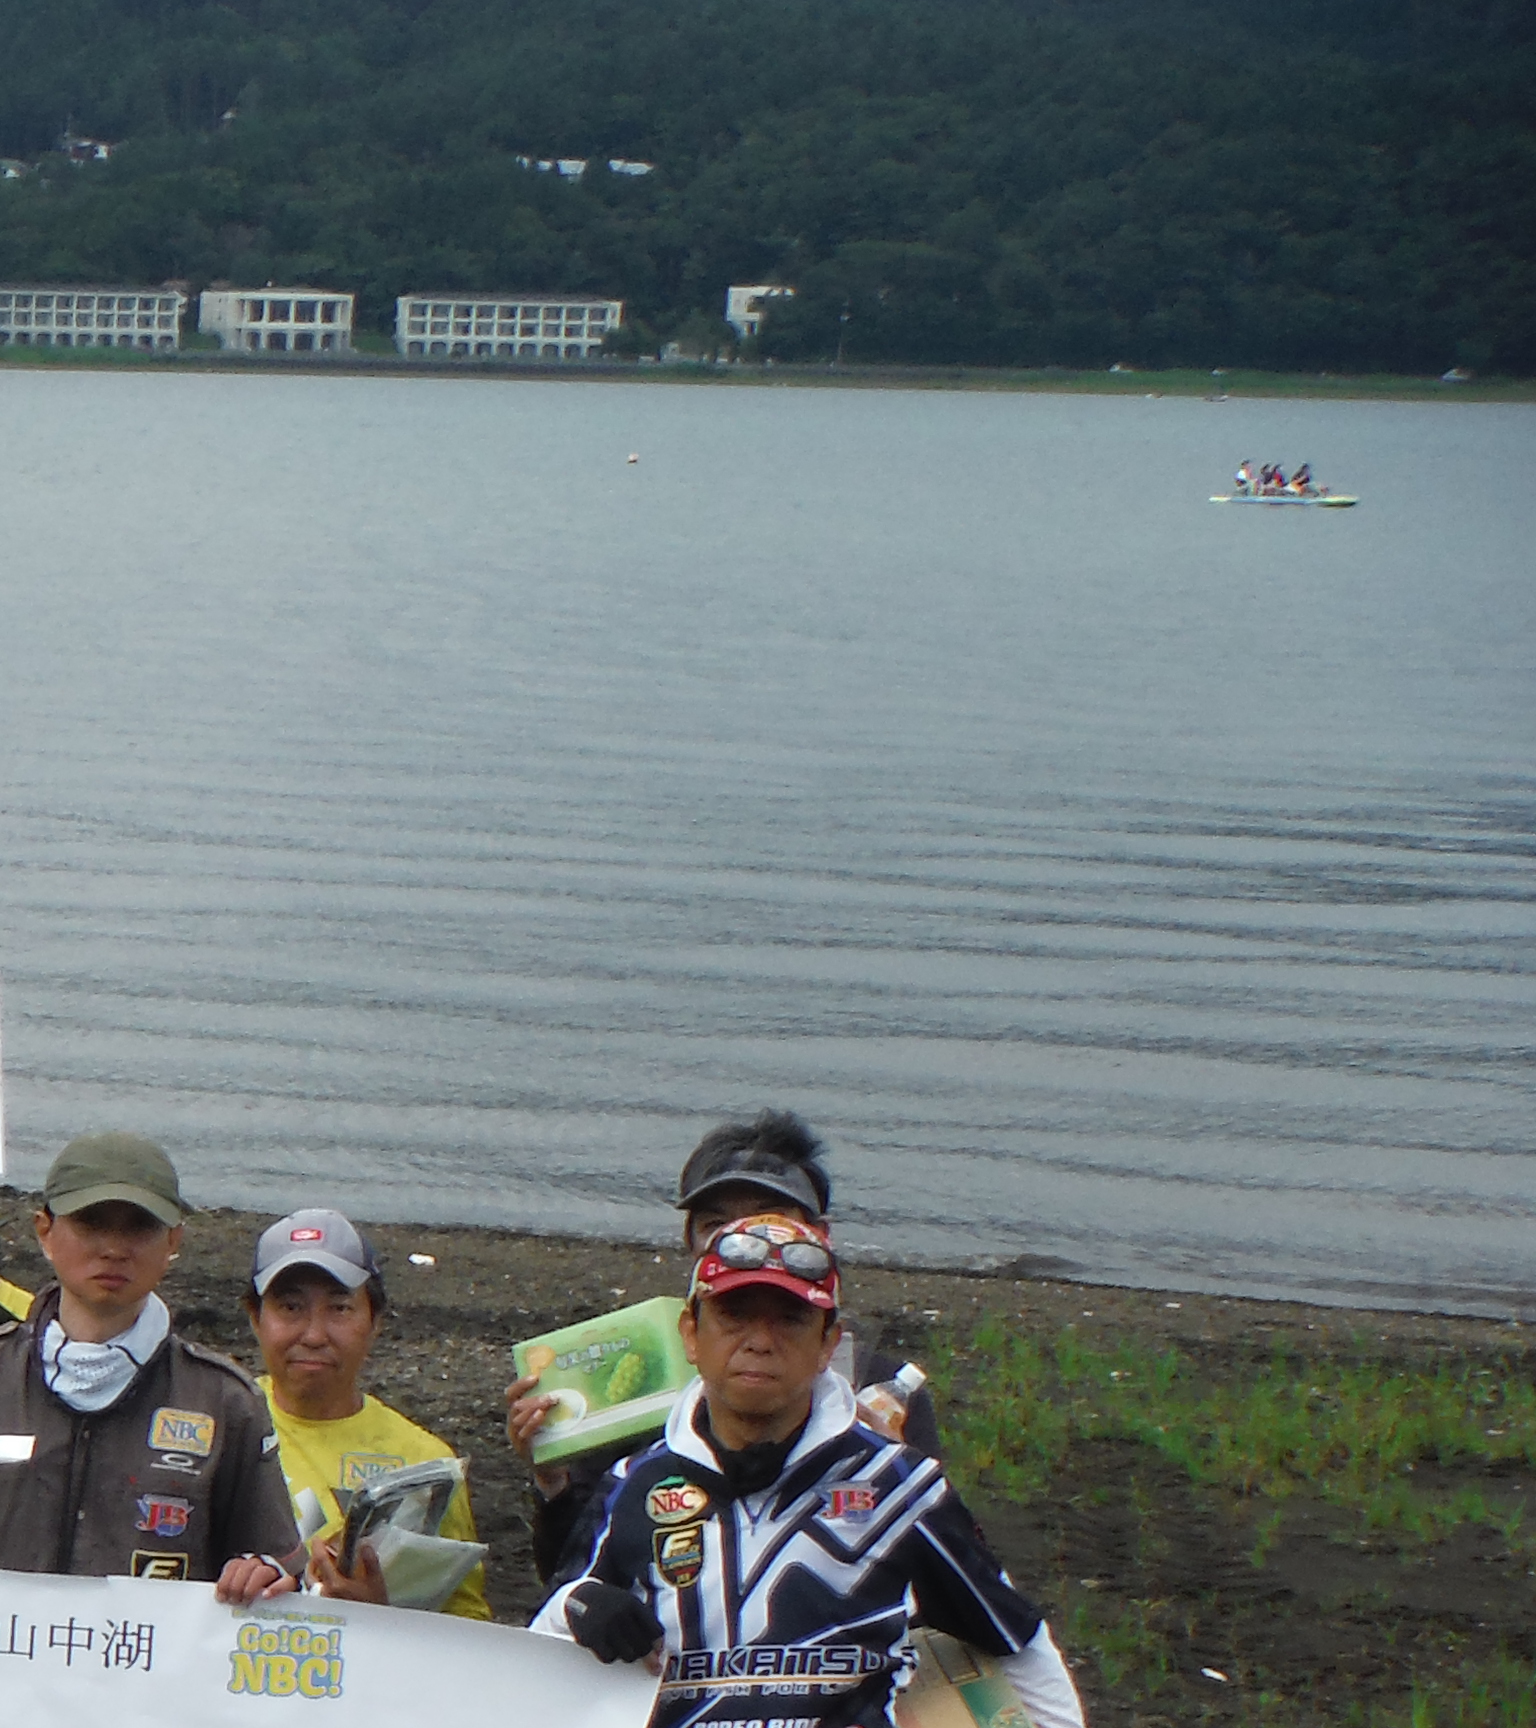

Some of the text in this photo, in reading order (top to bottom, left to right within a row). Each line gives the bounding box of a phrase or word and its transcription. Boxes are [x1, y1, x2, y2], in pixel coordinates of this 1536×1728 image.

[158, 1418, 210, 1448] NBC
[135, 1501, 189, 1531] JB
[650, 1489, 697, 1515] NBC
[822, 1489, 876, 1519] JB
[229, 1651, 343, 1698] NBC!
